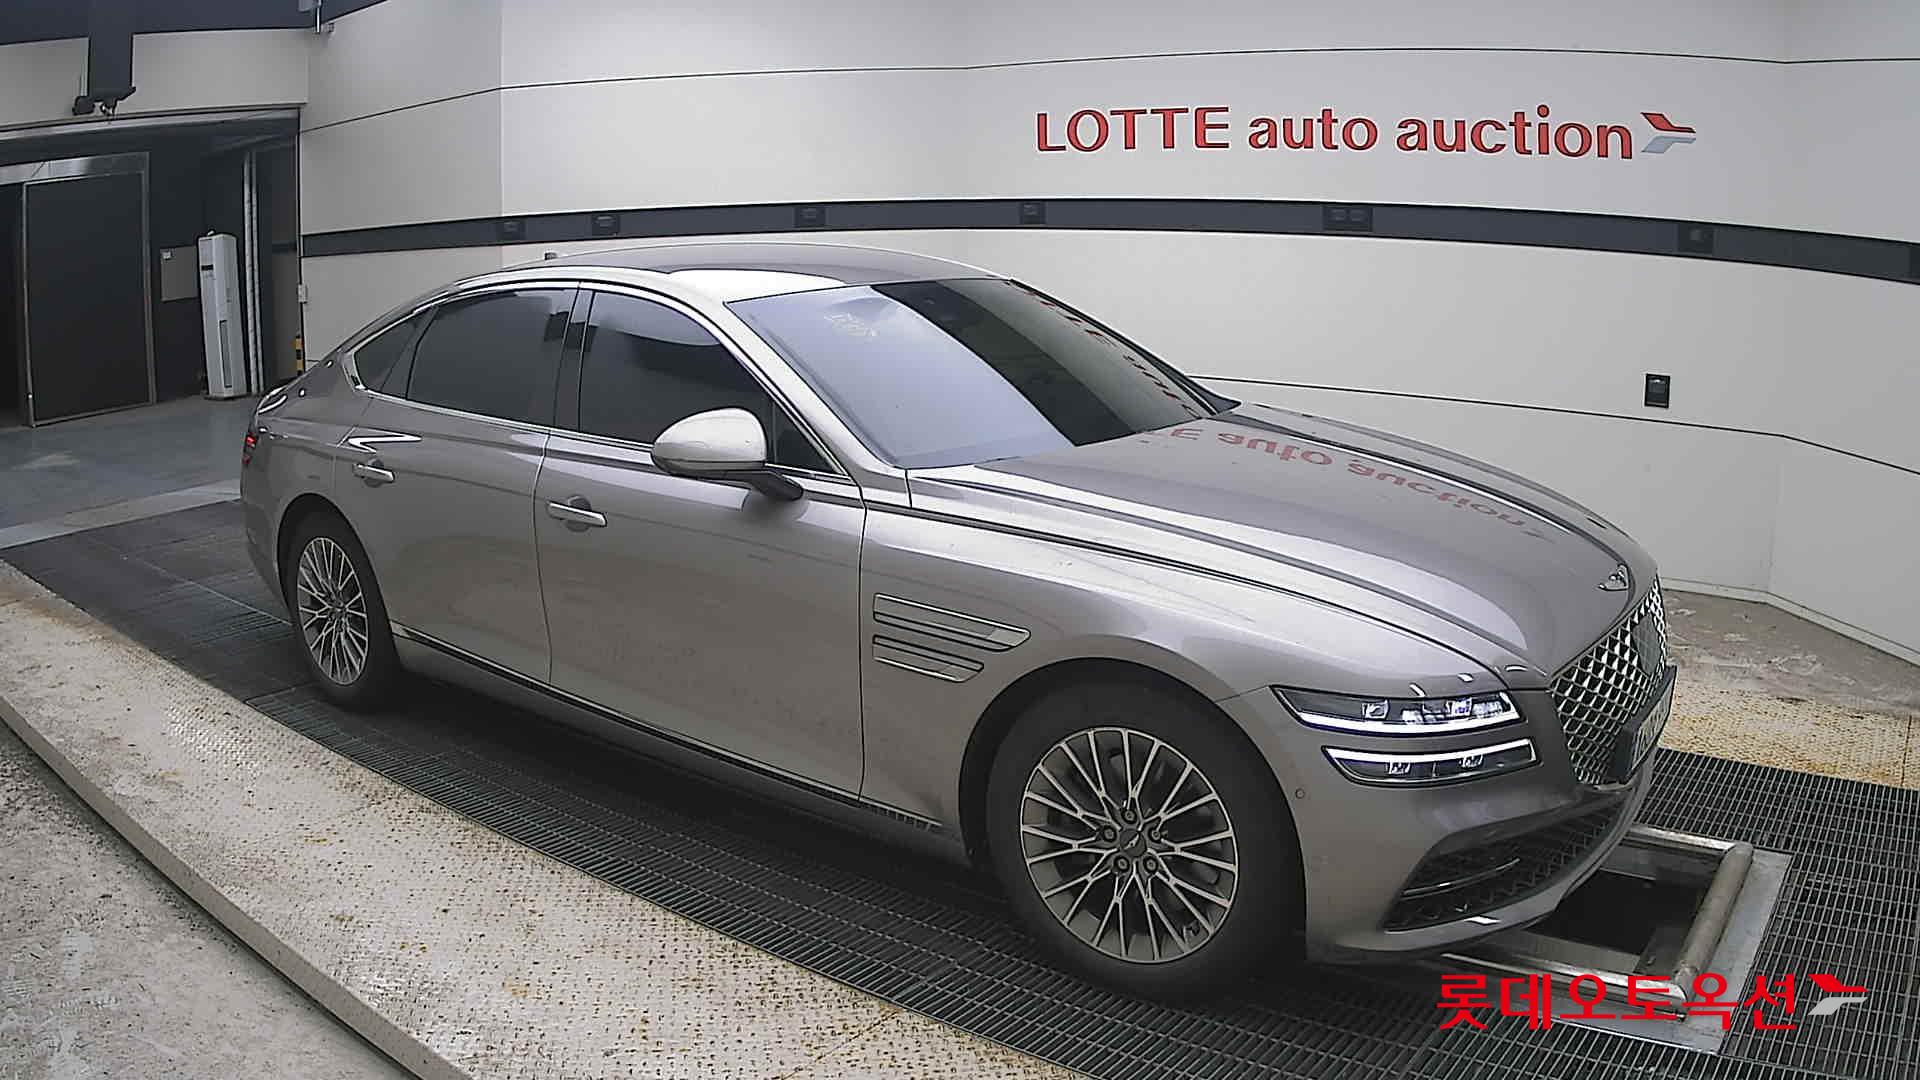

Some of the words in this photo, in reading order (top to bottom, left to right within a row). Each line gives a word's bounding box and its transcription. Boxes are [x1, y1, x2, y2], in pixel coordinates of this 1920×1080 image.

[1036, 106, 1229, 152] LOTTE
[1248, 108, 1378, 151] auto
[1396, 103, 1633, 159] auction
